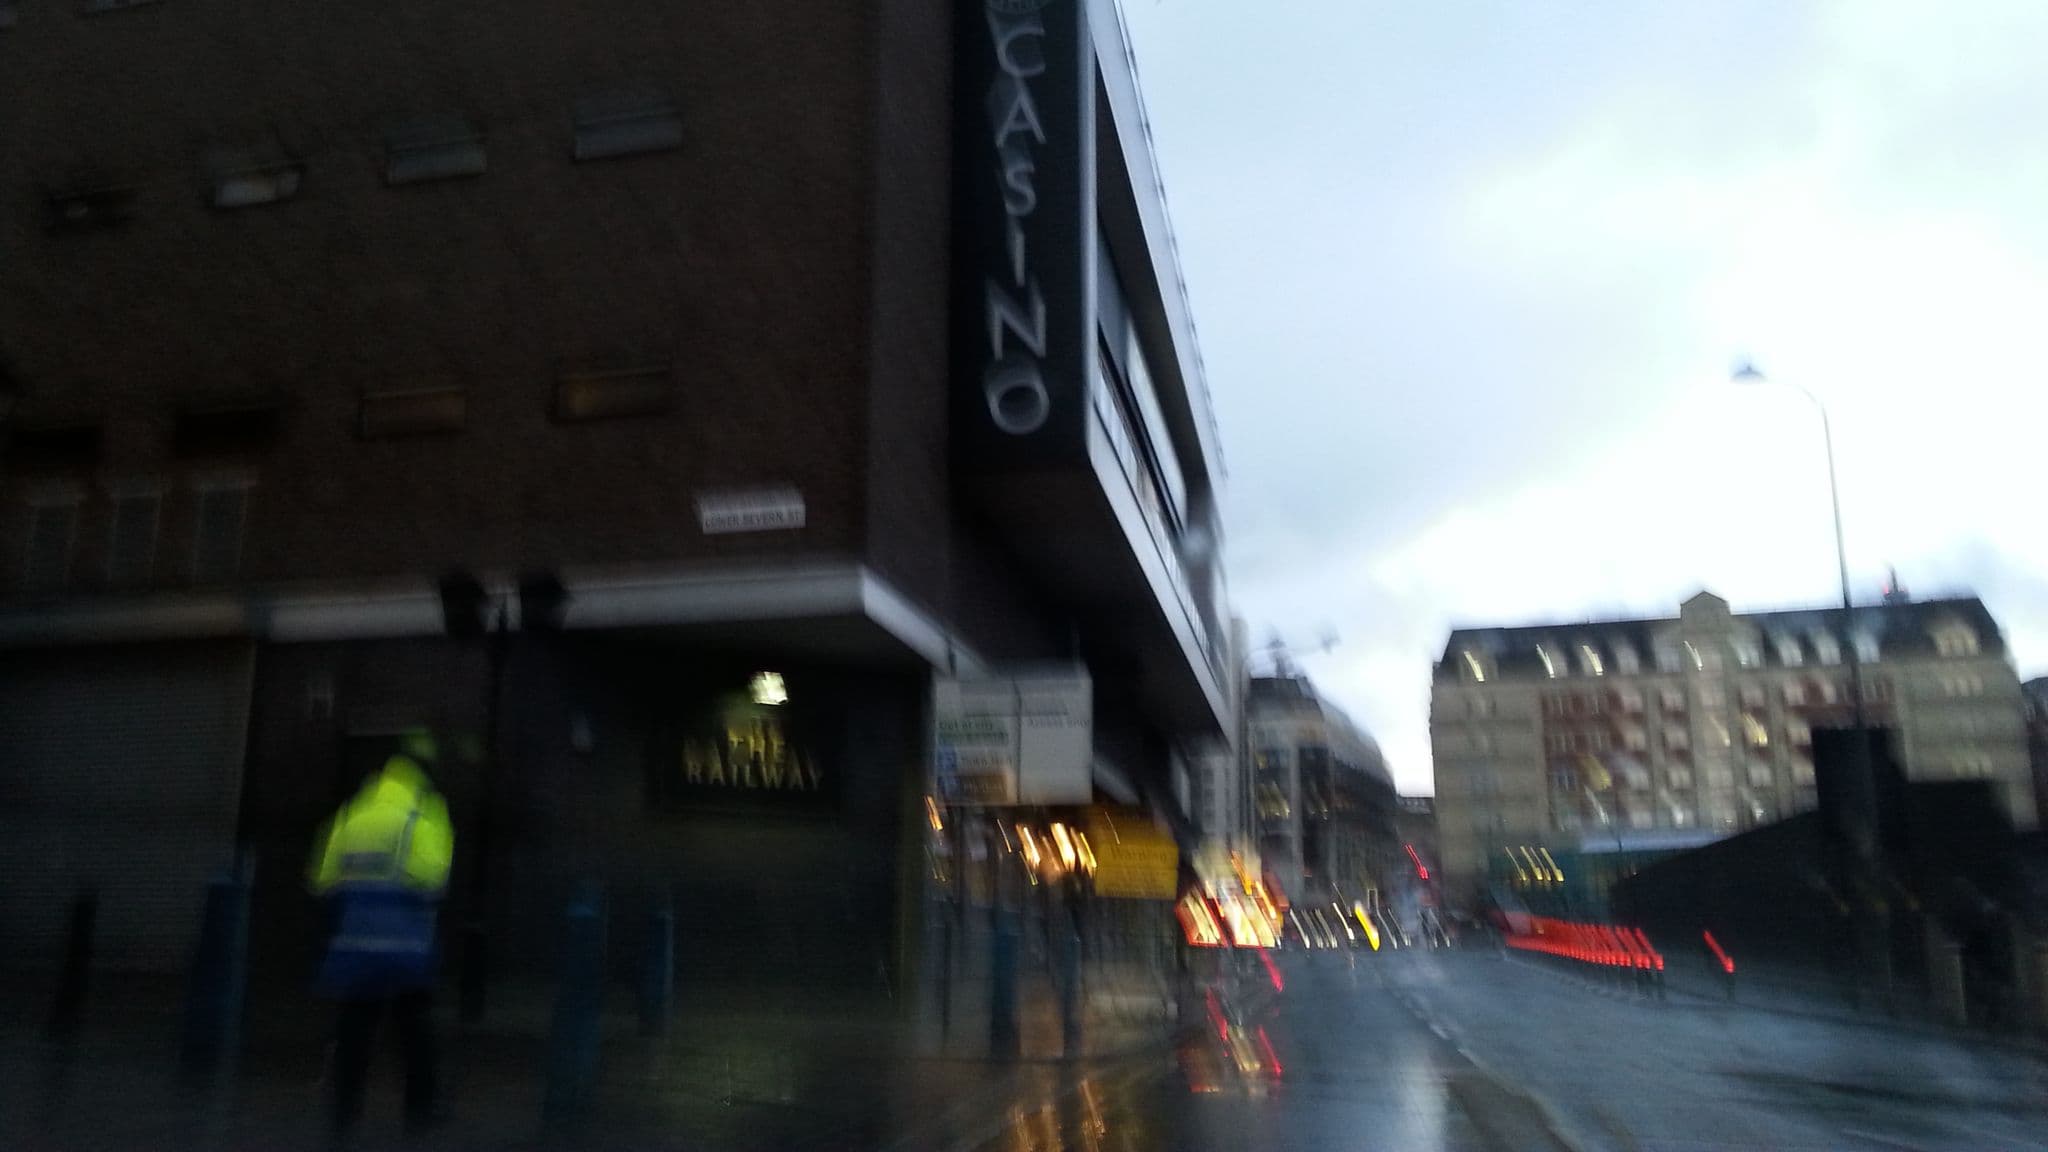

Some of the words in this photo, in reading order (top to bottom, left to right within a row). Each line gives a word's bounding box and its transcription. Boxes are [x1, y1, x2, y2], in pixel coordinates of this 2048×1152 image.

[984, 25, 1050, 436] CASINO
[728, 730, 785, 763] THE
[682, 753, 823, 791] RAILWAY
